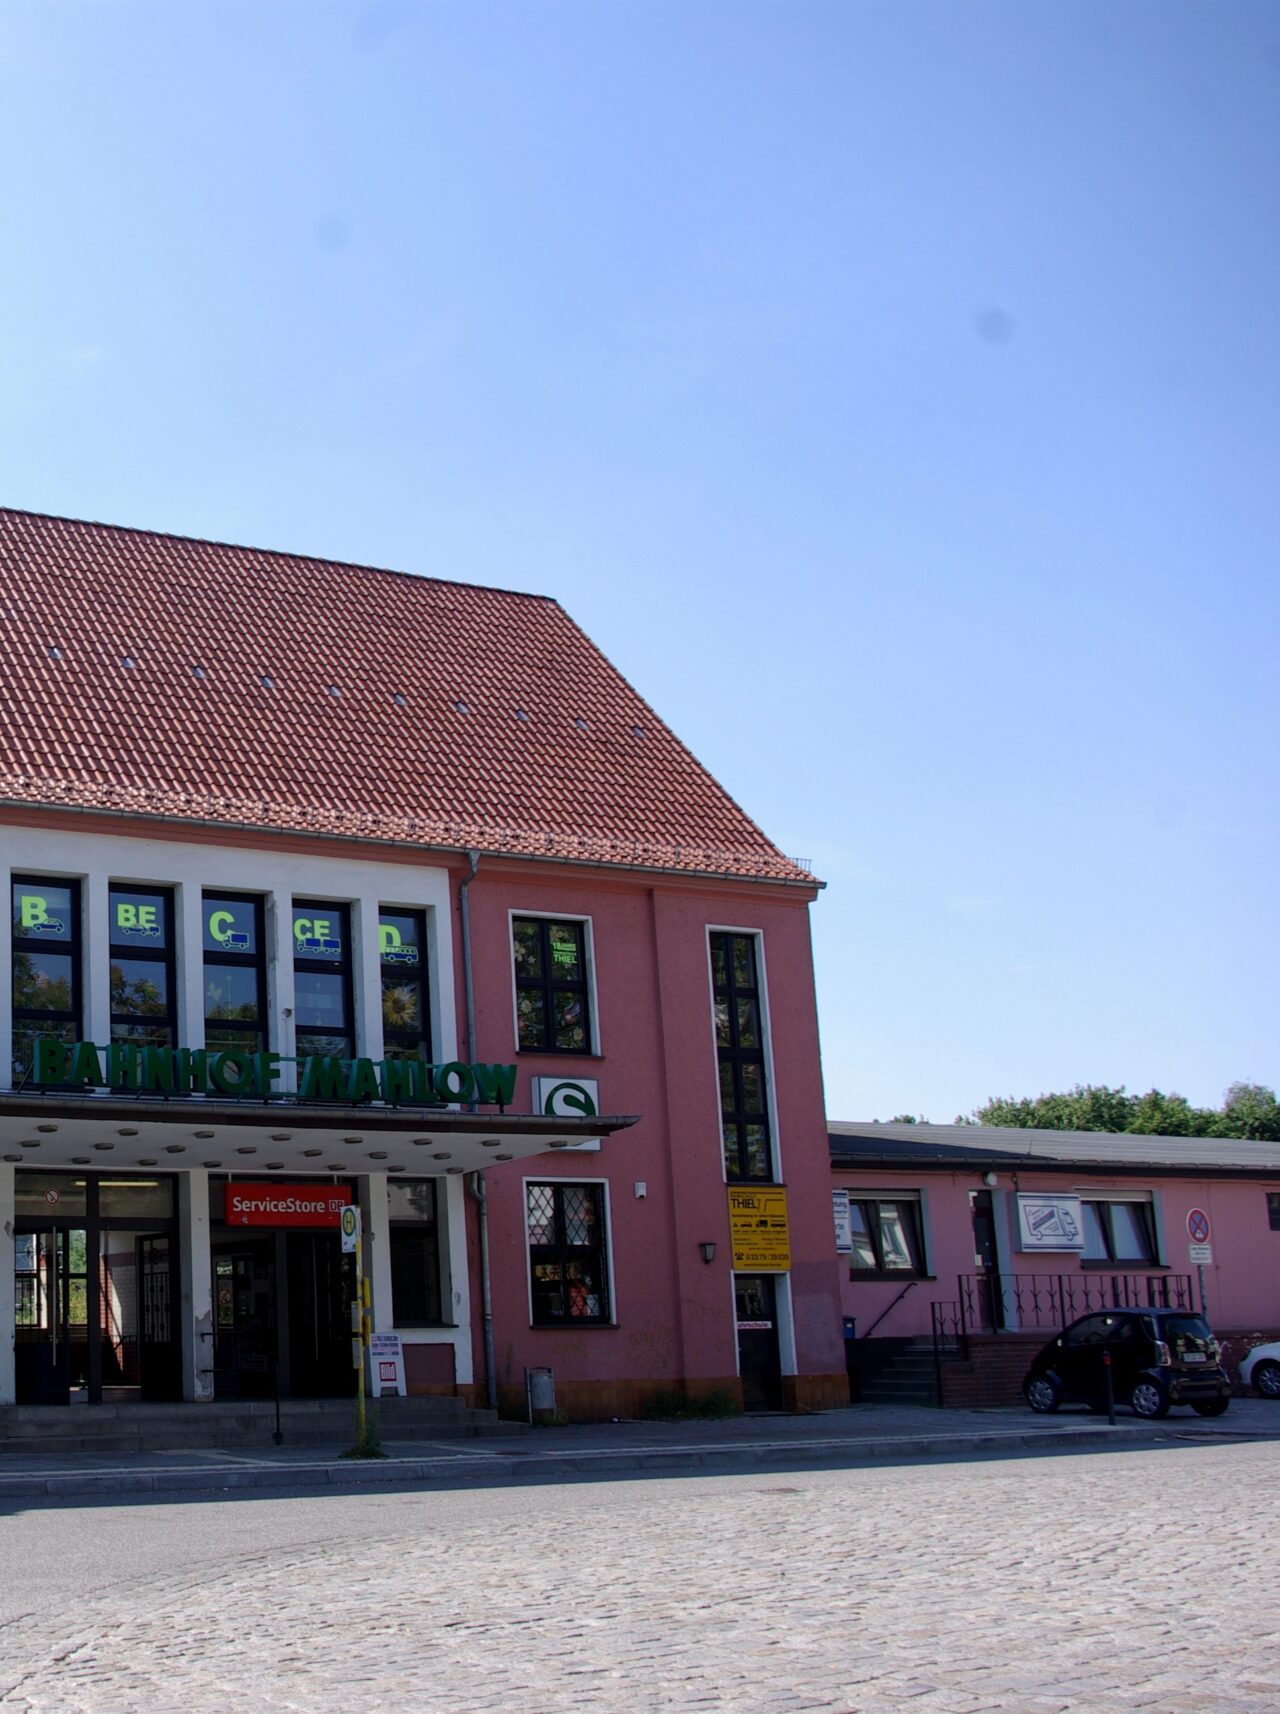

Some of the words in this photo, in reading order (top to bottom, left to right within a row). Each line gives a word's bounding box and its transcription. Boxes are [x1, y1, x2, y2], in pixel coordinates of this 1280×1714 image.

[22, 896, 49, 927] B
[117, 903, 157, 927] BE
[209, 911, 236, 942] C
[293, 918, 331, 940] CE
[379, 924, 401, 953] D
[553, 955, 578, 964] THIEL
[33, 1039, 281, 1095] BAHNHOF
[299, 1055, 517, 1105] MAHLOW
[232, 1196, 325, 1213] ServiceStore
[730, 1198, 758, 1209] THIEL
[380, 1363, 396, 1380] Bild
